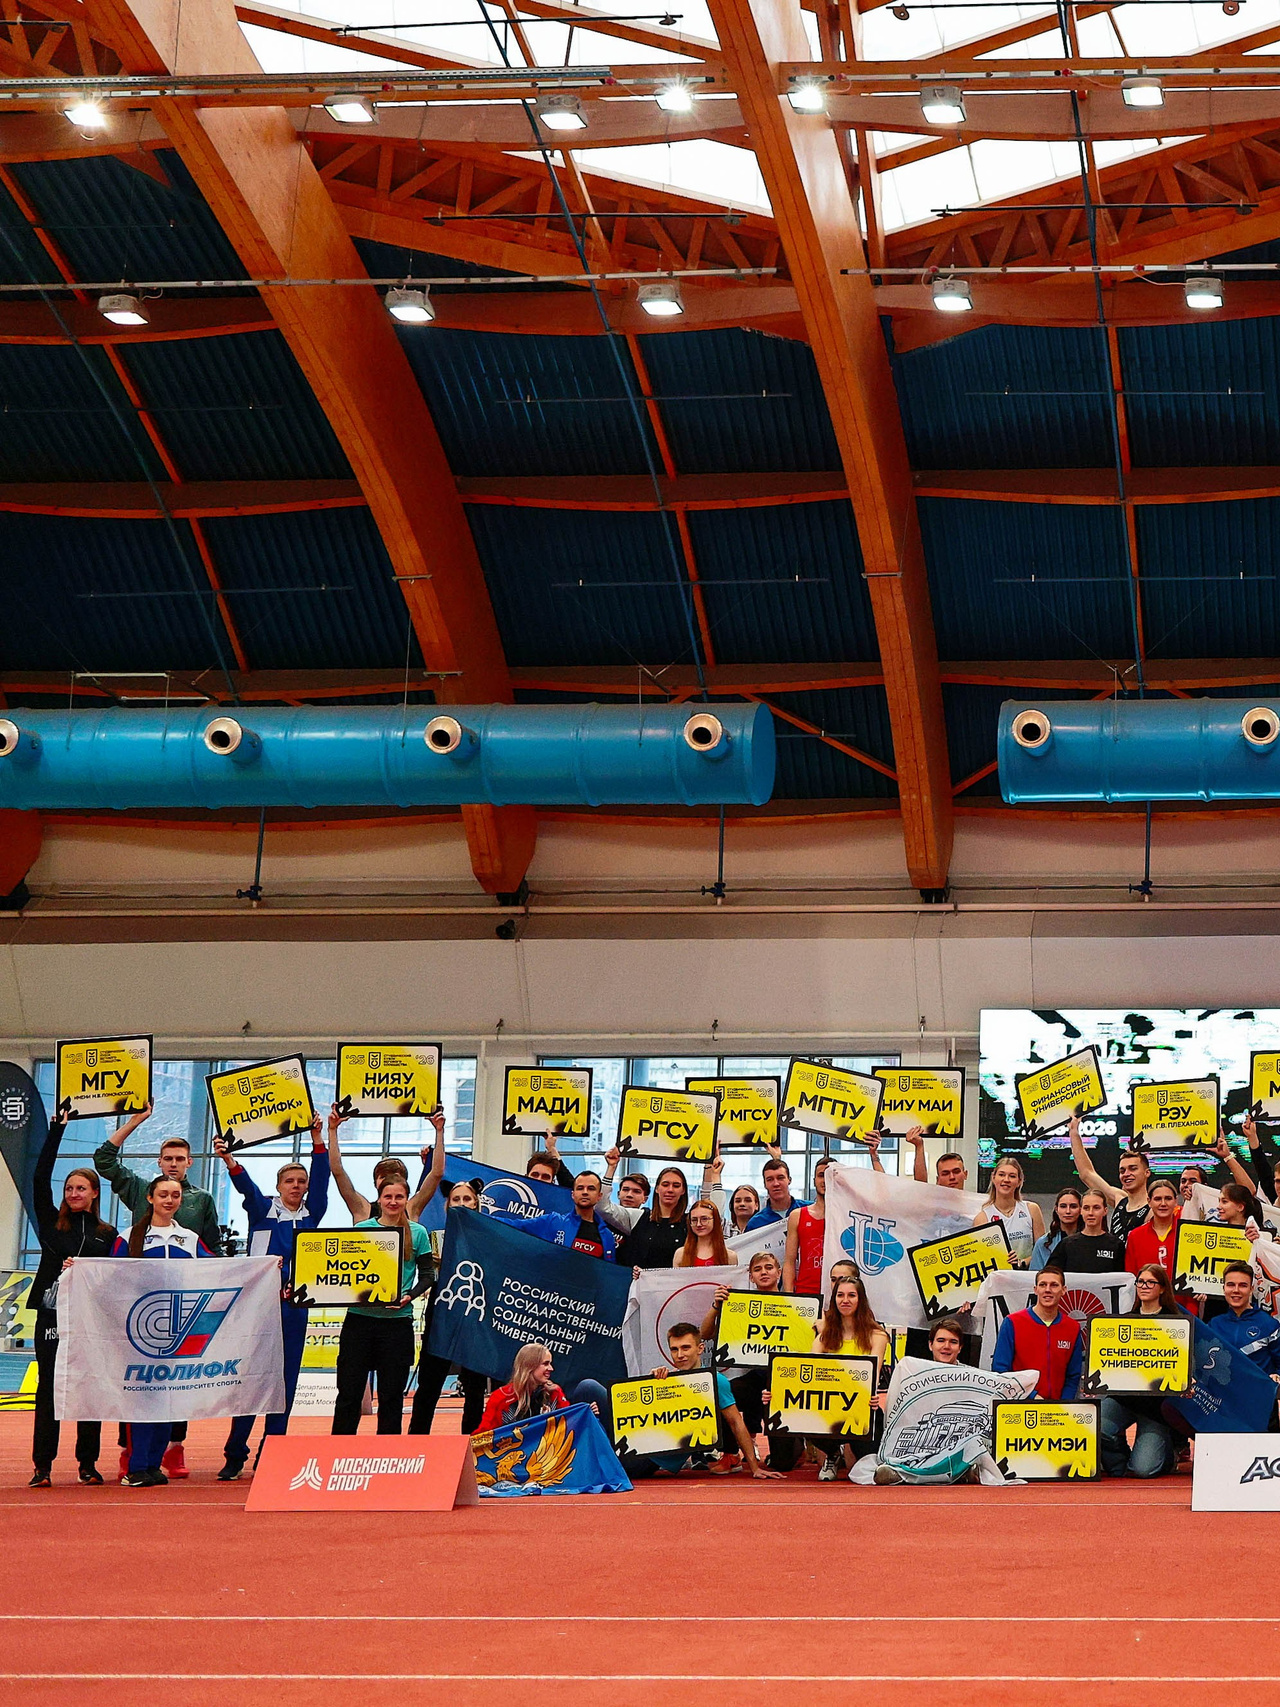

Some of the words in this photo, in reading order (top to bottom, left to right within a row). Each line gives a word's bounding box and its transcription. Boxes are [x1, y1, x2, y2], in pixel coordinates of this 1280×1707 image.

[82, 1069, 129, 1092] МГУ
[365, 1073, 414, 1084] НИЯУ
[250, 1091, 275, 1107] РУС
[362, 1087, 416, 1098] МИФИ
[1030, 1074, 1090, 1108] ФИНАНСОВЫЙ
[1032, 1083, 1092, 1115] УНИВЕРСИТЕТ
[227, 1100, 302, 1126] «ГЦОЛИФК»
[518, 1097, 579, 1116] МАДИ
[798, 1092, 865, 1120] МГПУ
[883, 1100, 915, 1111] НИУ
[919, 1100, 953, 1111] МАИ
[1158, 1106, 1192, 1121] РЭУ
[730, 1109, 772, 1121] МГСУ
[638, 1120, 699, 1139] РГСУ
[1168, 1120, 1209, 1128] ПЛЕХАНОВА
[507, 1201, 544, 1218] МАДИ
[575, 1242, 595, 1251] РГСУ
[327, 1259, 371, 1270] МосУ
[316, 1274, 351, 1286] МВД
[356, 1273, 380, 1284] РФ
[934, 1258, 998, 1293] РУДН
[503, 1277, 595, 1316] РОССИЙСКИЙ
[497, 1292, 623, 1339] ГОСУДАРСТВЕННЫЙ
[45, 1327, 59, 1340] MS
[493, 1306, 587, 1344] СОЦИАЛЬНЫЙ
[747, 1324, 789, 1341] РУТ
[492, 1318, 572, 1355] УНИВЕРСИТЕТ
[1099, 1347, 1179, 1357] СЕЧЕНОВСКИЙ
[124, 1359, 242, 1383] ГЦОЛИФК
[1101, 1360, 1178, 1369] УНИВЕРСИТЕТ
[168, 1383, 215, 1391] УНИВЕРСИТЕТ
[784, 1389, 859, 1411] МПГУ
[617, 1415, 649, 1431] РТУ
[653, 1406, 713, 1426] МИРЭА
[1006, 1438, 1043, 1451] НИУ
[1048, 1438, 1087, 1451] МЭИ
[331, 1454, 426, 1474] МОСКОВСКИЙ
[327, 1475, 372, 1491] СПОРТ
